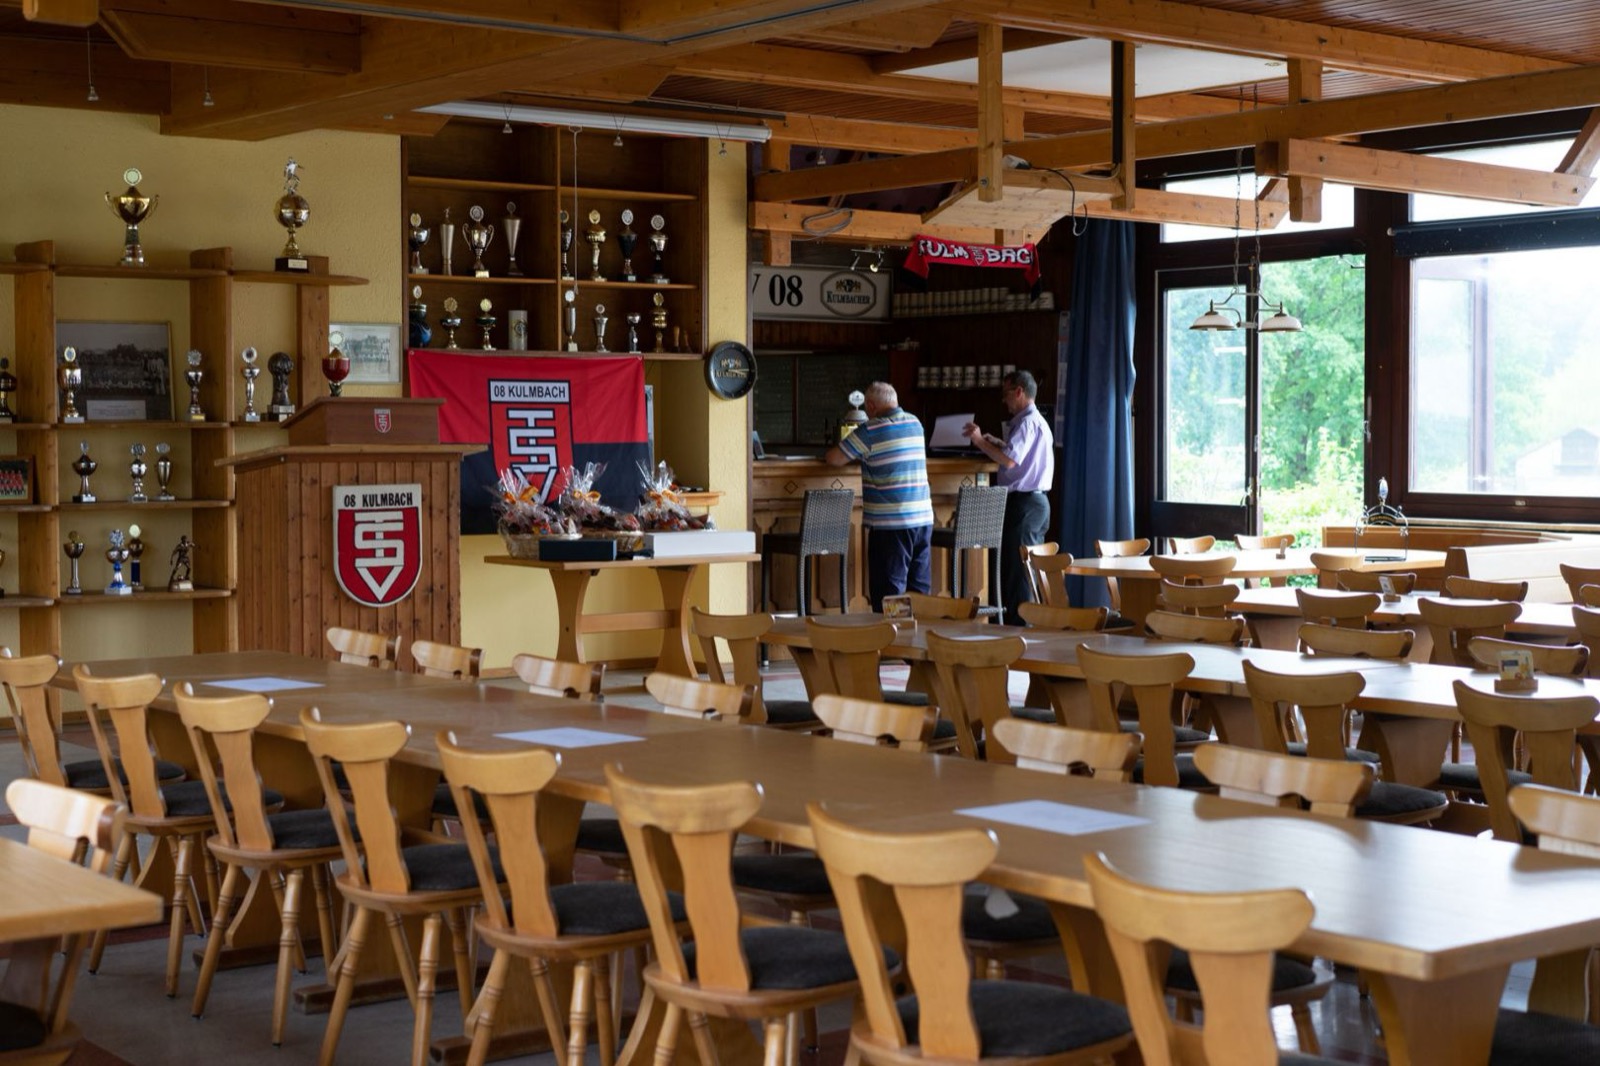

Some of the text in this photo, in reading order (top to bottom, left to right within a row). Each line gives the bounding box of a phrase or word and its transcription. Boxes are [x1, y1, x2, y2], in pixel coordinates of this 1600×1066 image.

[985, 248, 1034, 264] BAC
[769, 274, 803, 307] 08
[826, 291, 870, 304] KULMBACHER
[494, 385, 566, 398] 08 KULMBACH
[344, 492, 413, 507] 08 KULMBACH
